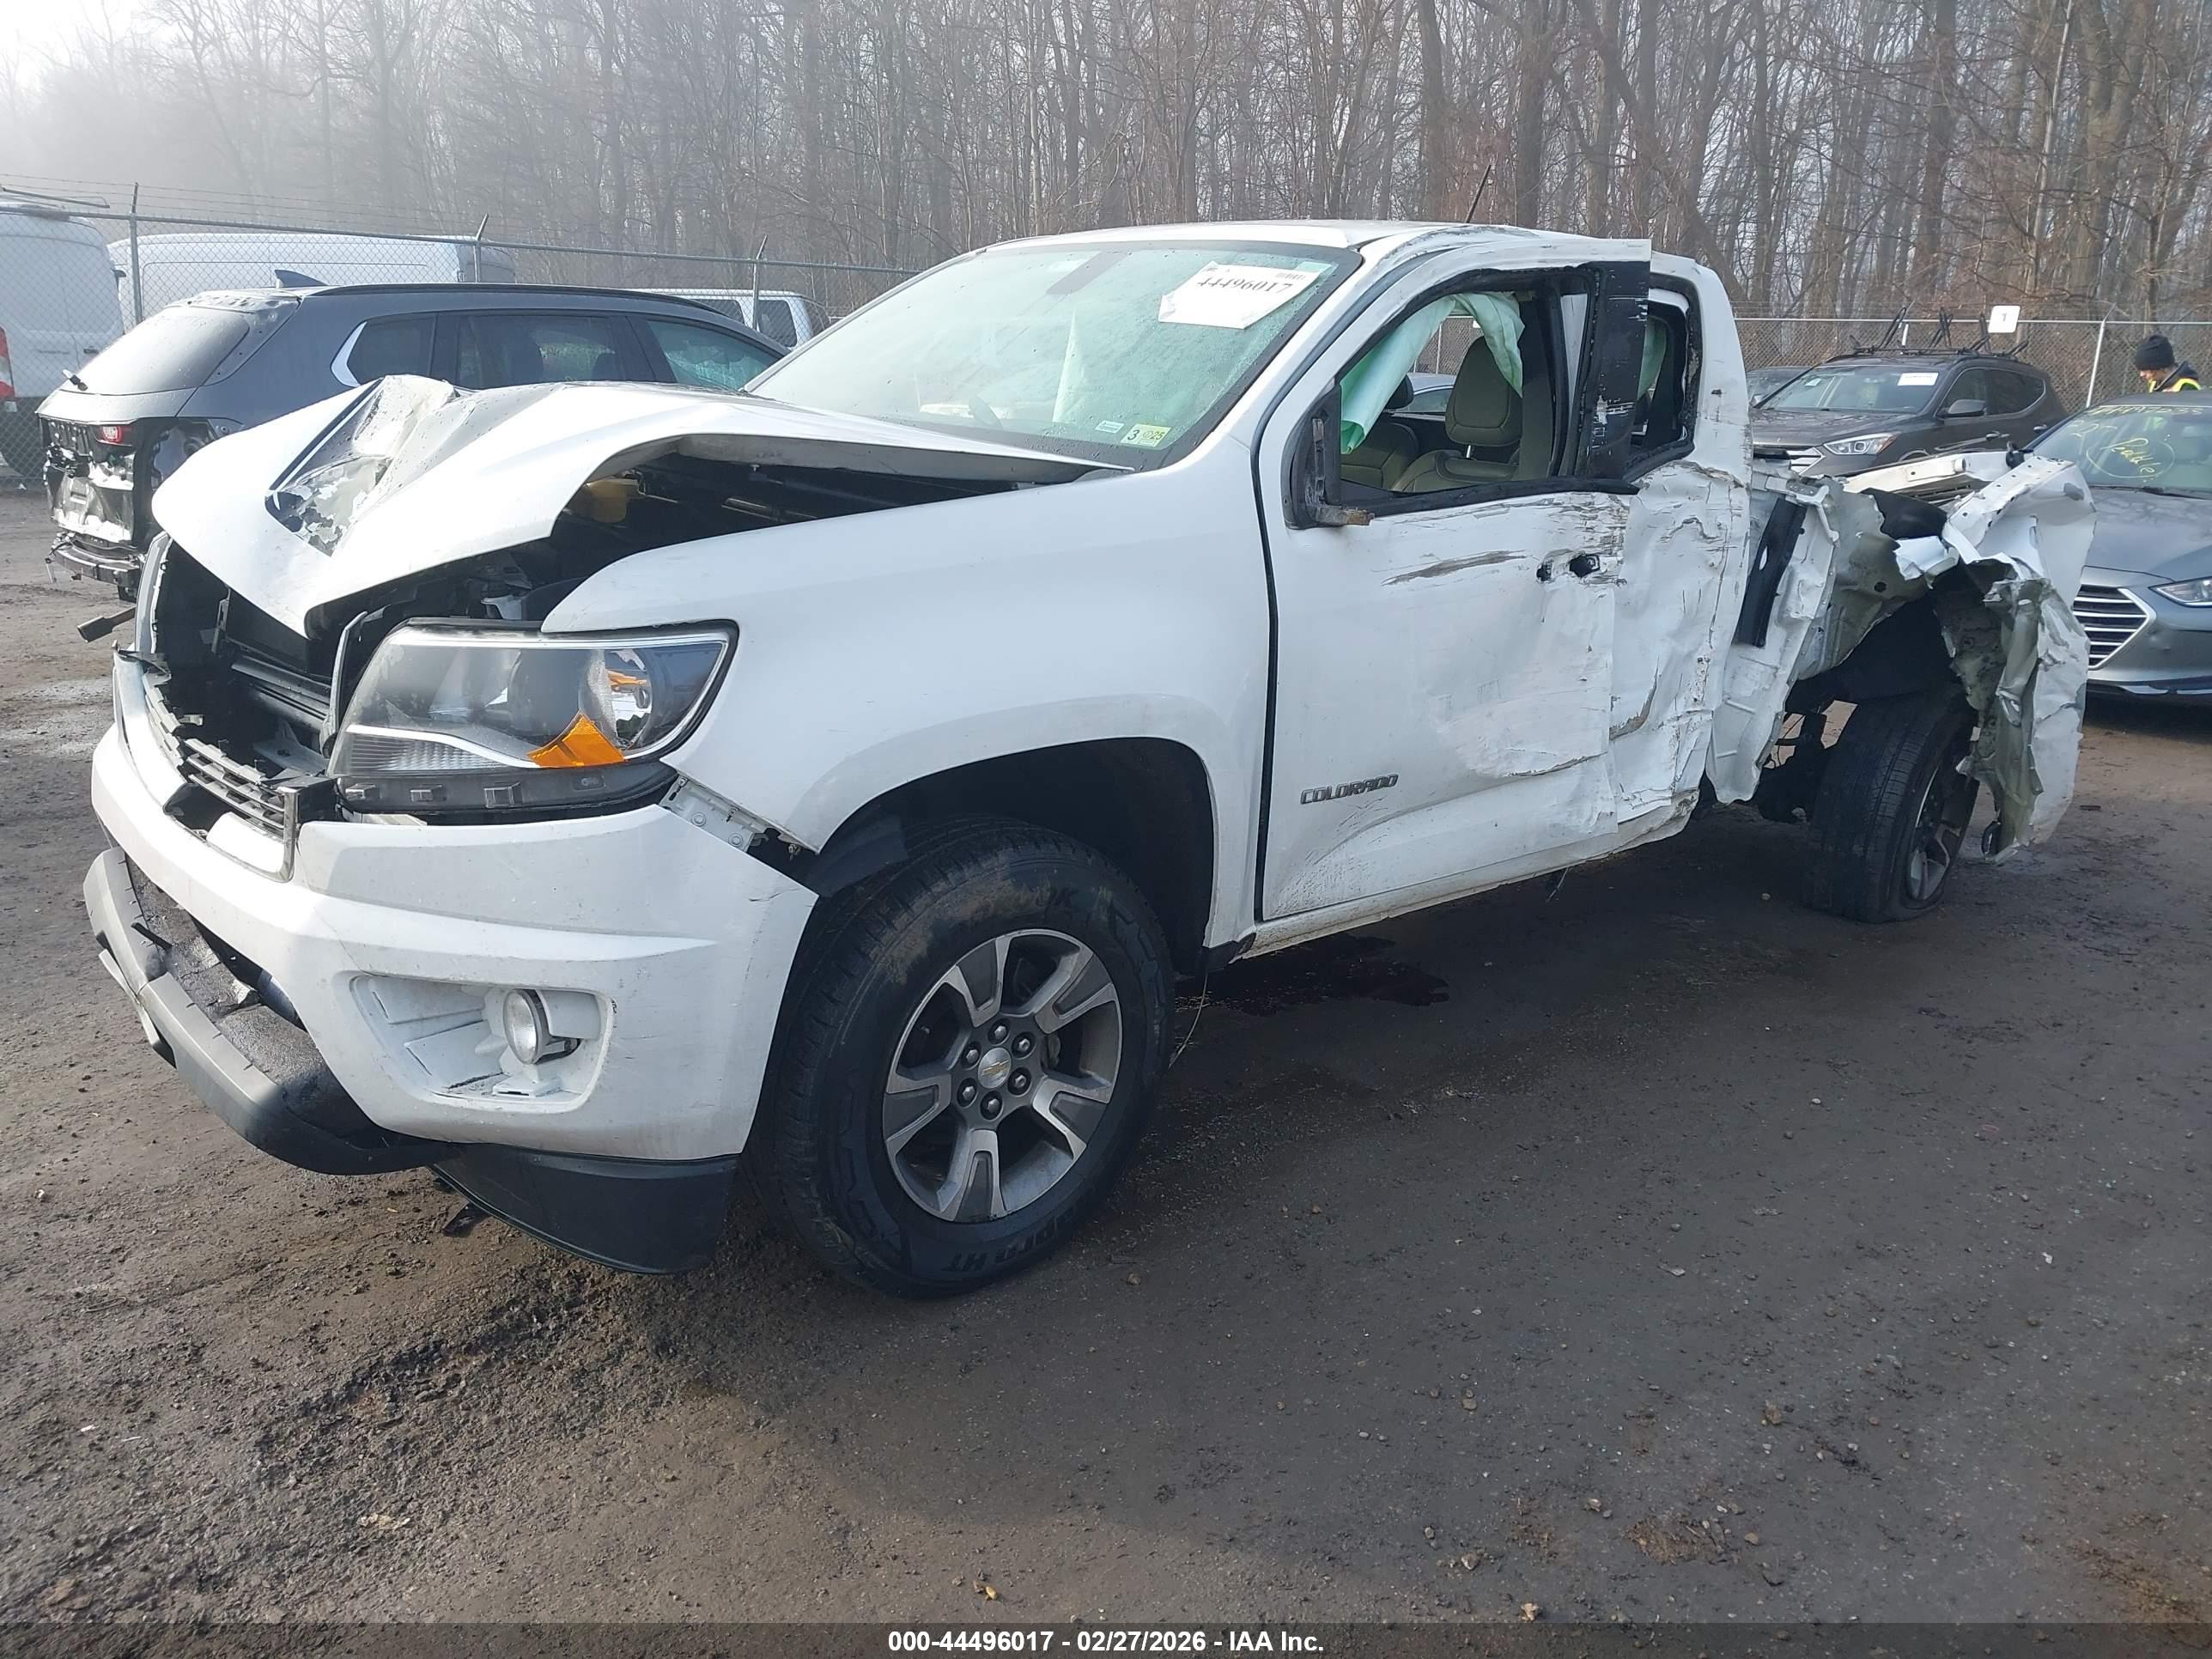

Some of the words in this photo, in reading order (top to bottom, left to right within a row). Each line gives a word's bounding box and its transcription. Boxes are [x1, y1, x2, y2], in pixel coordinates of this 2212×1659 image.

[1197, 276, 1294, 294] 44496017
[1127, 429, 1140, 441] 3
[1151, 431, 1165, 441] 25
[1300, 773, 1399, 805] COLORADO
